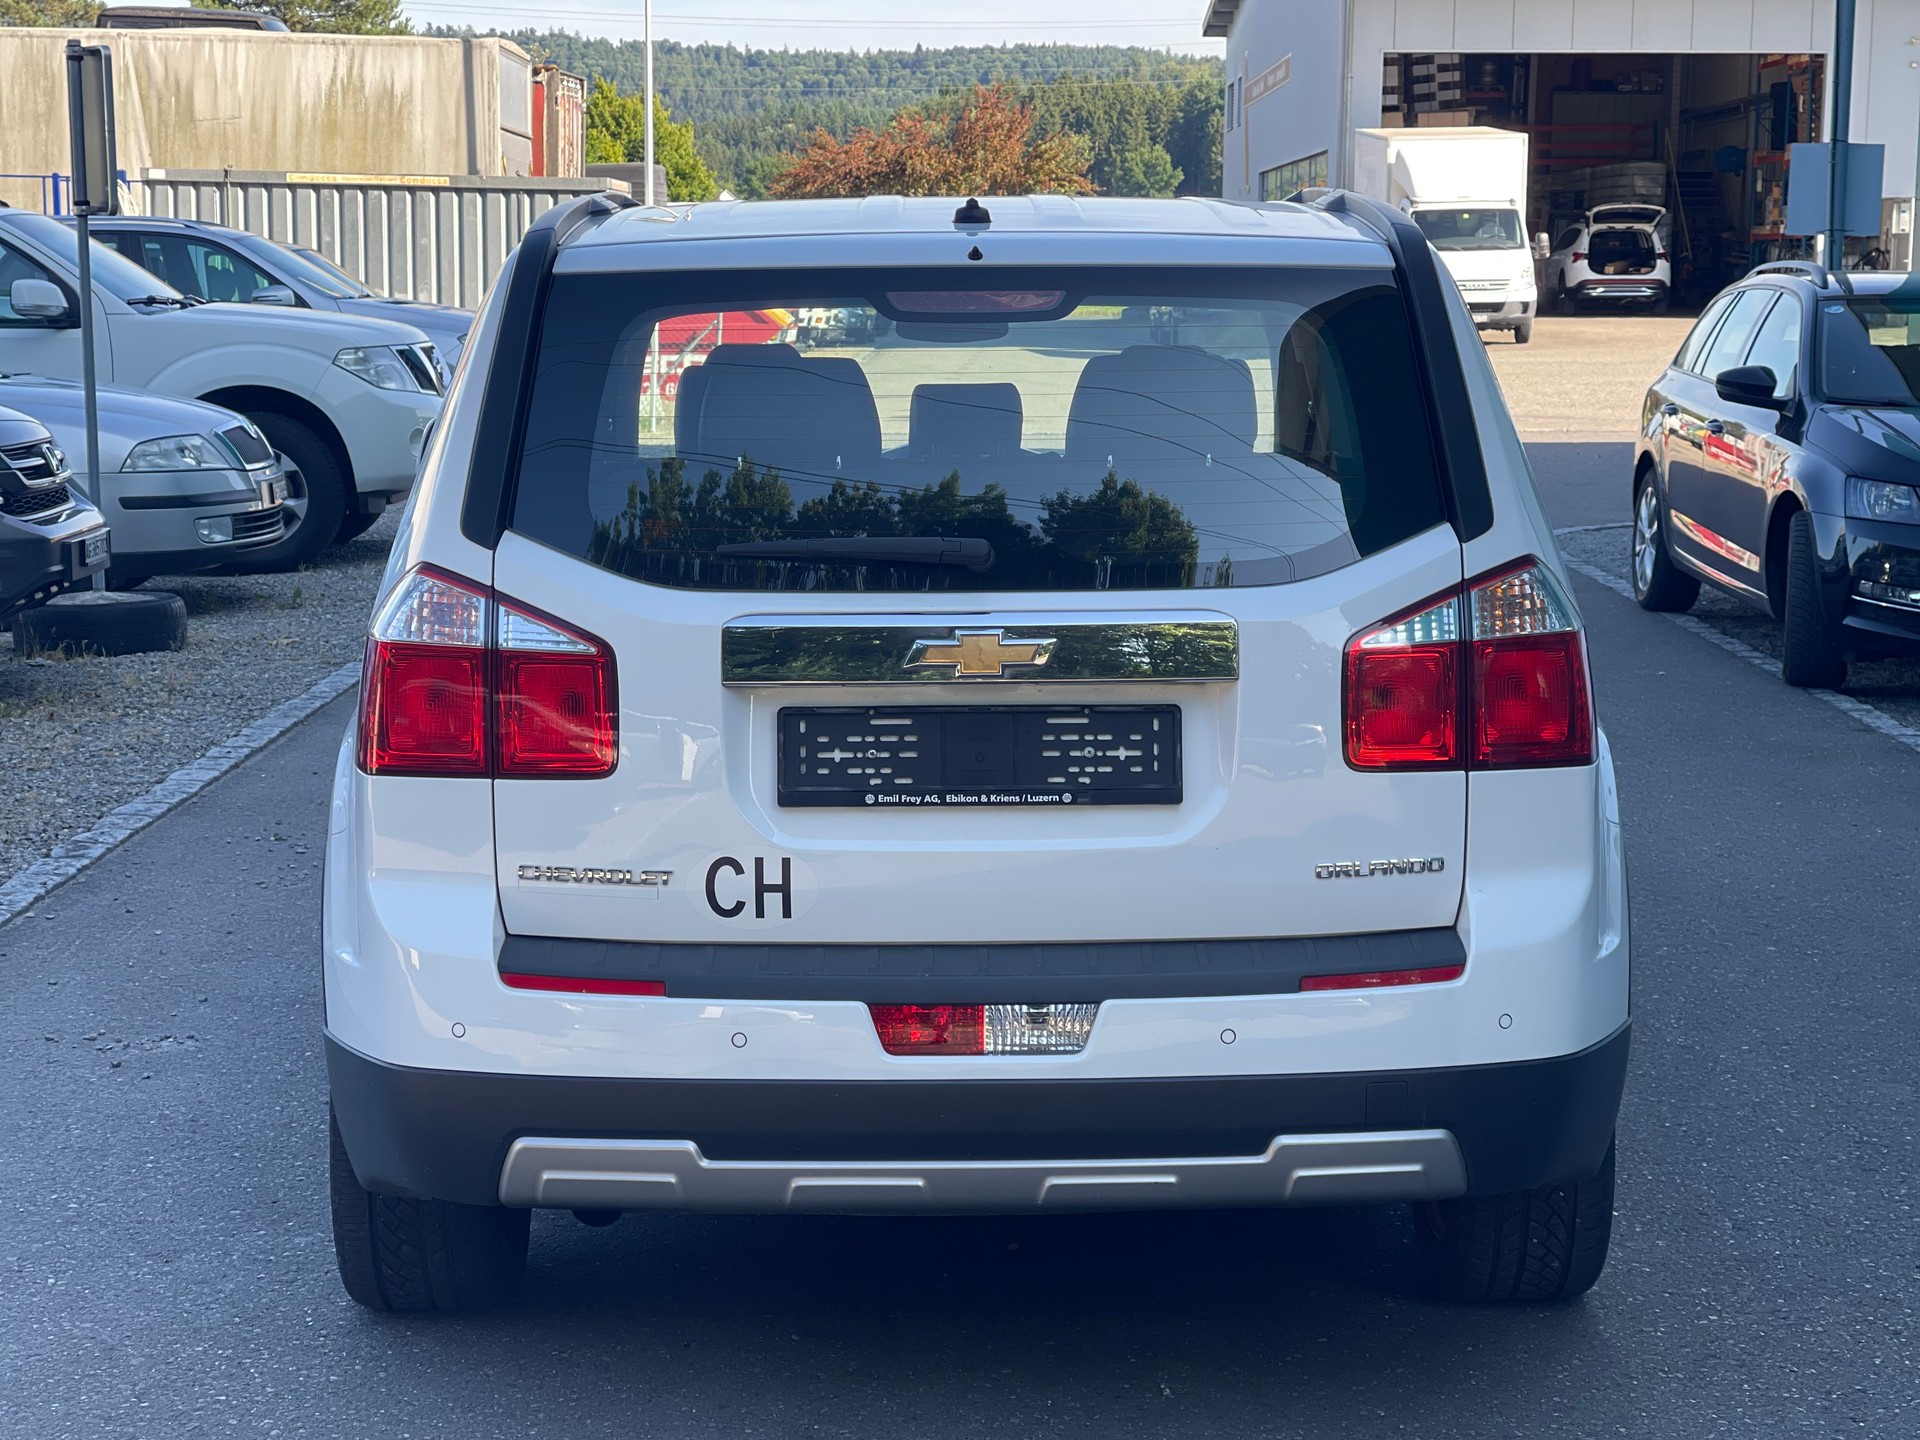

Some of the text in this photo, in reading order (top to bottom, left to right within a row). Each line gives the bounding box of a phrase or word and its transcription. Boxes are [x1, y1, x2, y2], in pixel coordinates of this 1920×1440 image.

[878, 794, 899, 803] Emil
[901, 794, 922, 805] Frey
[924, 794, 941, 804] AG,
[946, 794, 979, 803] Ebikon
[980, 794, 988, 803] &
[990, 794, 1020, 803] Kriens
[1027, 794, 1060, 803] Luzern
[517, 864, 674, 886] CHEVROLET
[1315, 856, 1445, 880] ORLANDO
[705, 855, 792, 919] CH
